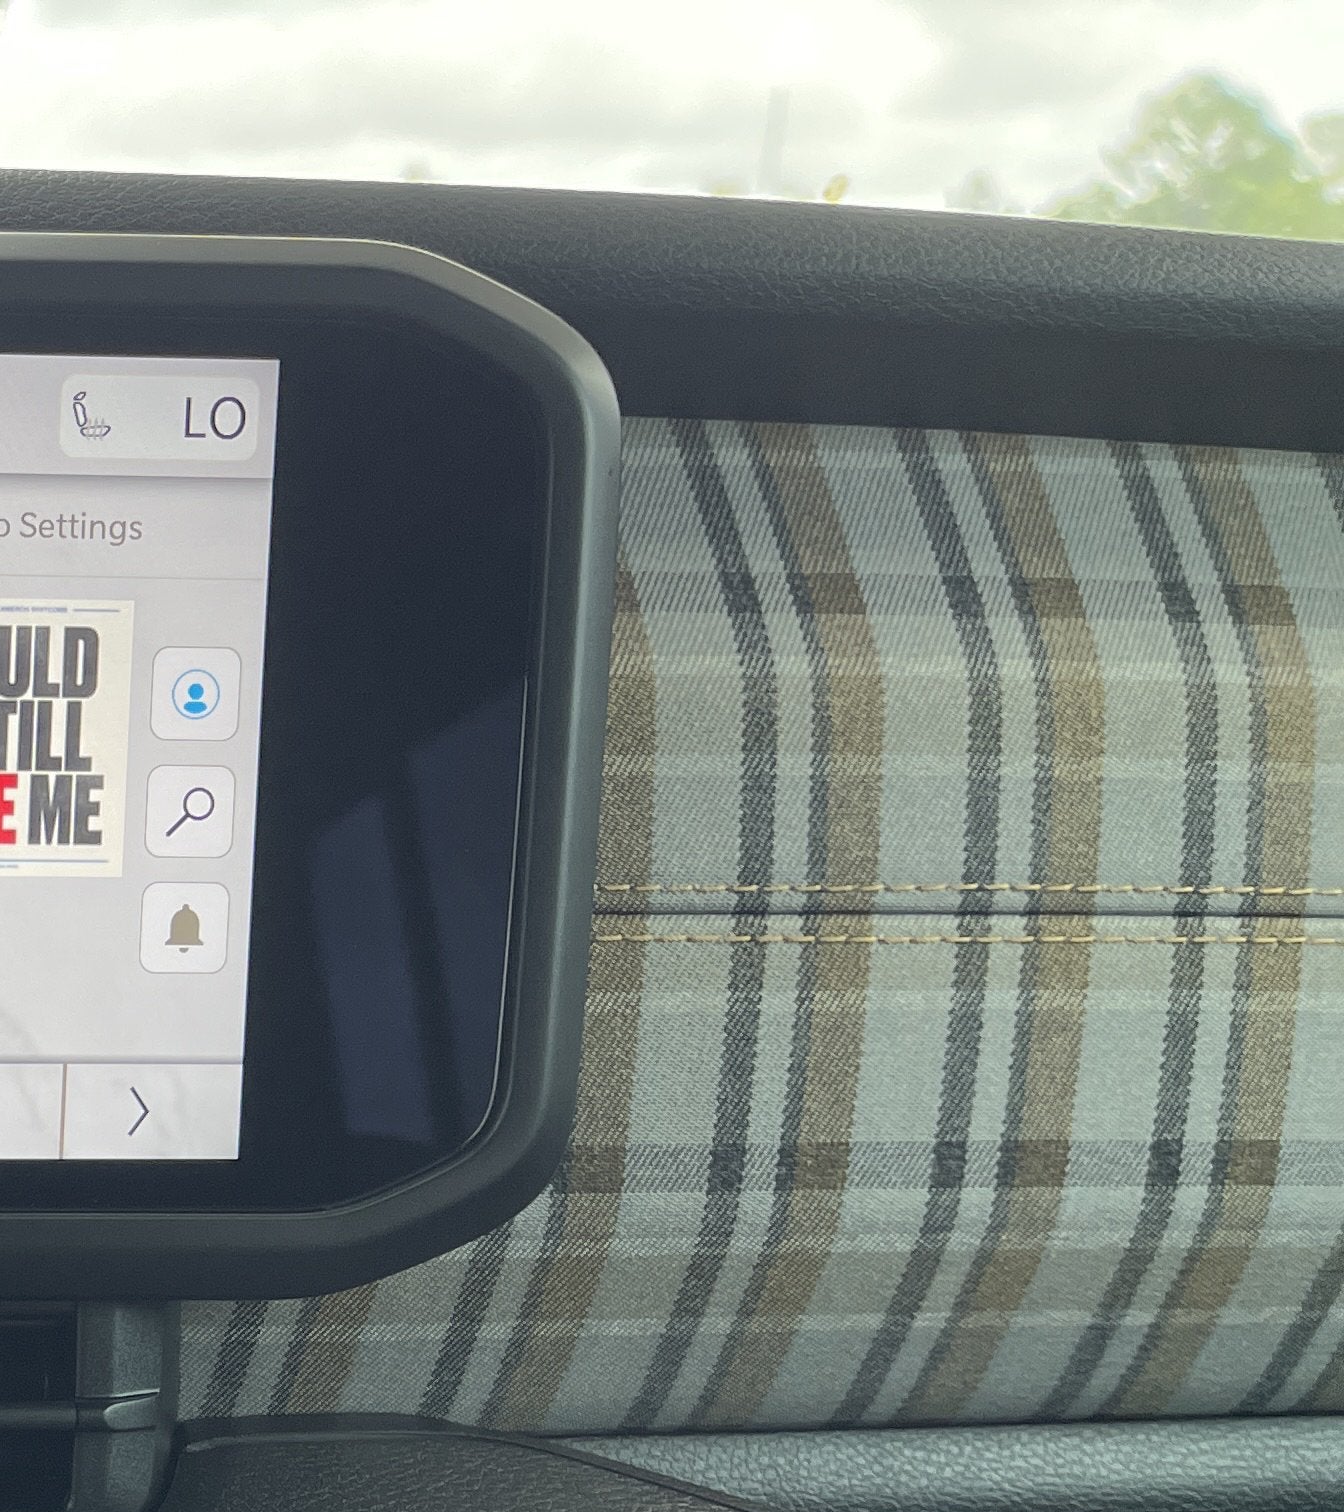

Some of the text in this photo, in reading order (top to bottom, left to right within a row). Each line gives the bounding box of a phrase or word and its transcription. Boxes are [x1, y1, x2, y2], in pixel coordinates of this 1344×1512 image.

[185, 396, 246, 440] LO
[20, 512, 143, 545] Settings
[28, 774, 104, 845] ME
